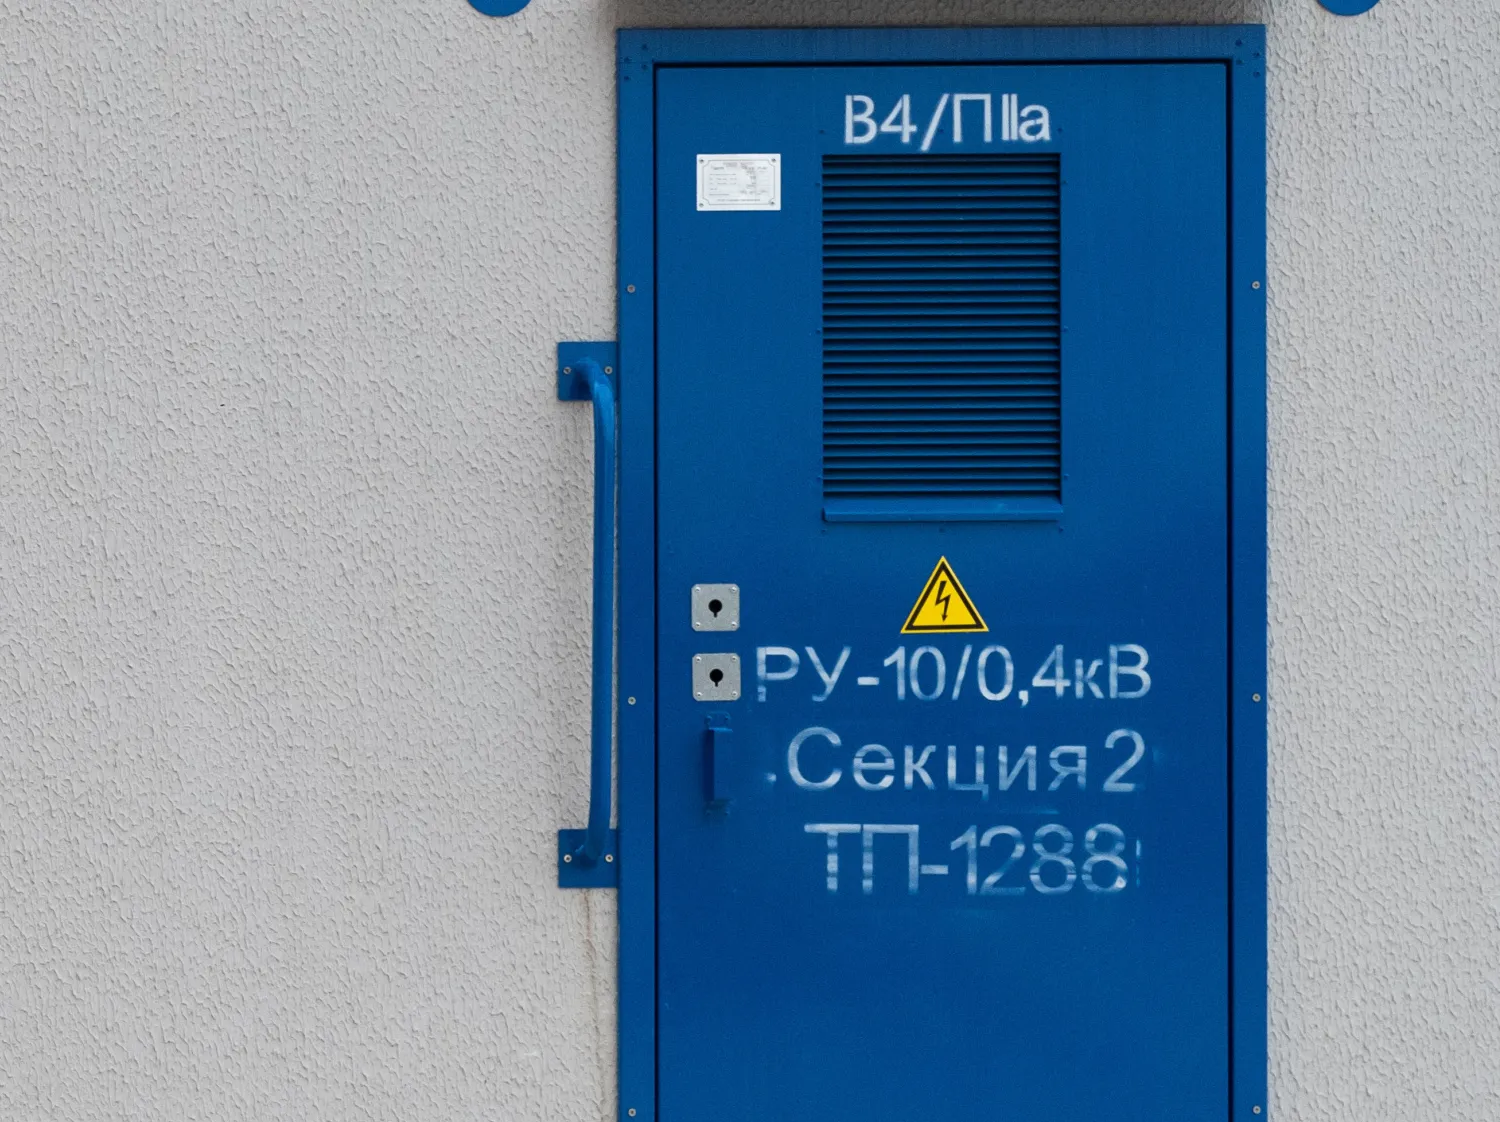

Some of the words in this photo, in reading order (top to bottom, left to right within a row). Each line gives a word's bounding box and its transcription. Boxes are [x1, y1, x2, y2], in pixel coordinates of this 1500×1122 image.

[756, 643, 1152, 707] РУ-10/0,4кВ
[787, 726, 1088, 799] Секция
[1103, 728, 1146, 792] 2
[804, 822, 1127, 895] ТП-1288
